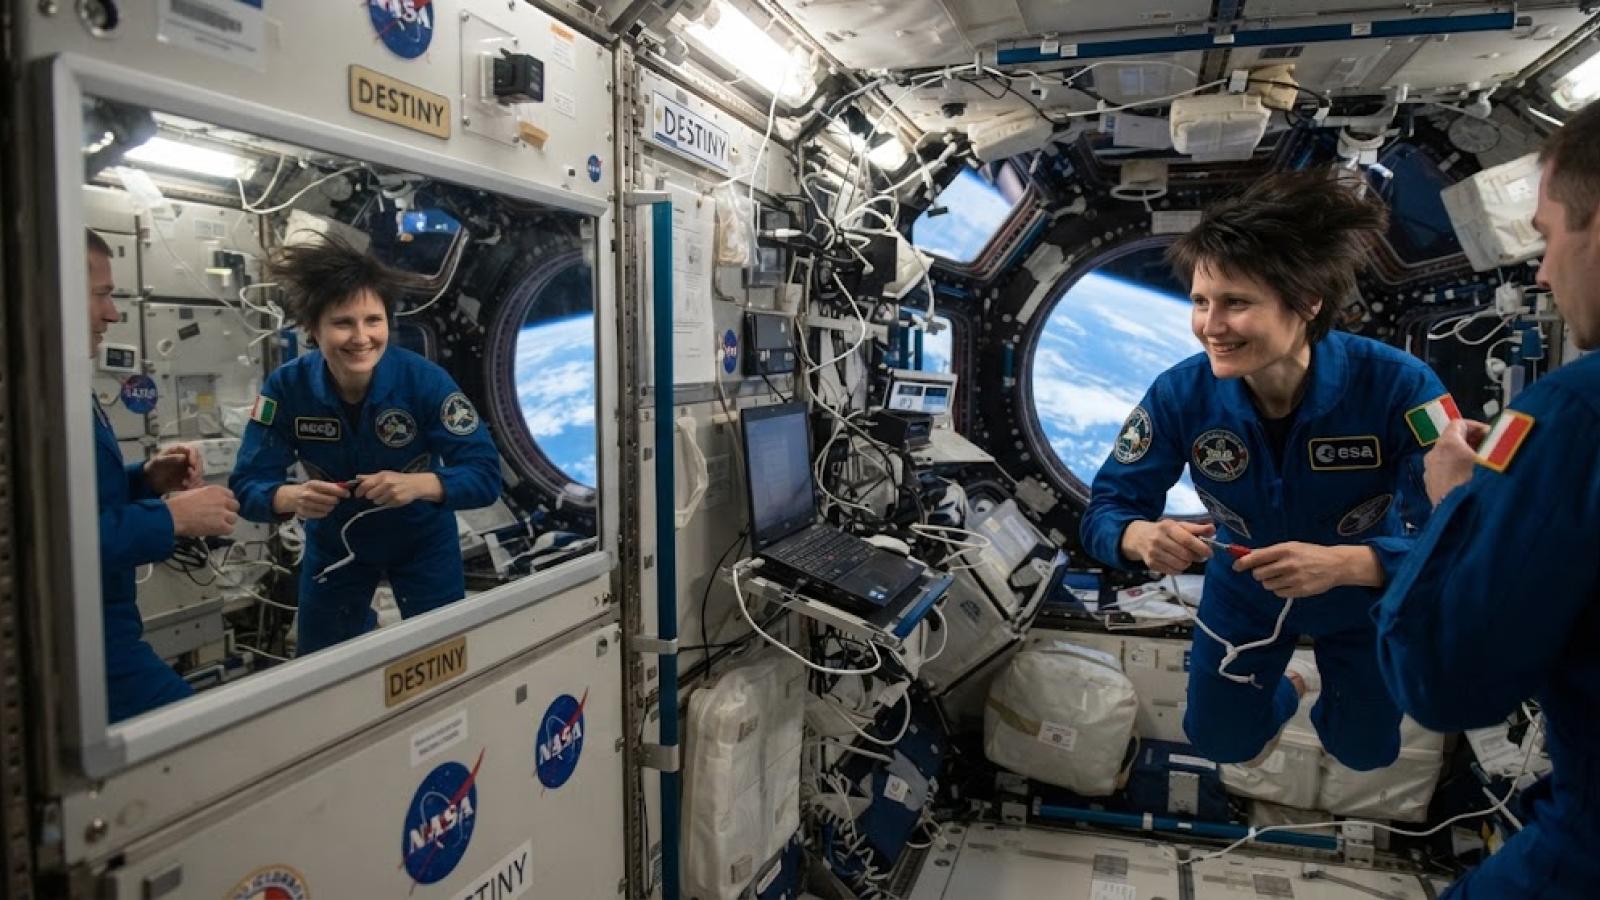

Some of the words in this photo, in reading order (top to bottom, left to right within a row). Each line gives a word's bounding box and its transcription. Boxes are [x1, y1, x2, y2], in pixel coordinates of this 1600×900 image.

[359, 78, 444, 127] DESTINY
[664, 106, 726, 160] DESTINY
[1338, 445, 1375, 459] esa
[390, 646, 465, 698] DESTINY
[540, 721, 582, 766] NASA
[409, 796, 474, 853] NASA
[464, 852, 527, 900] TINY
